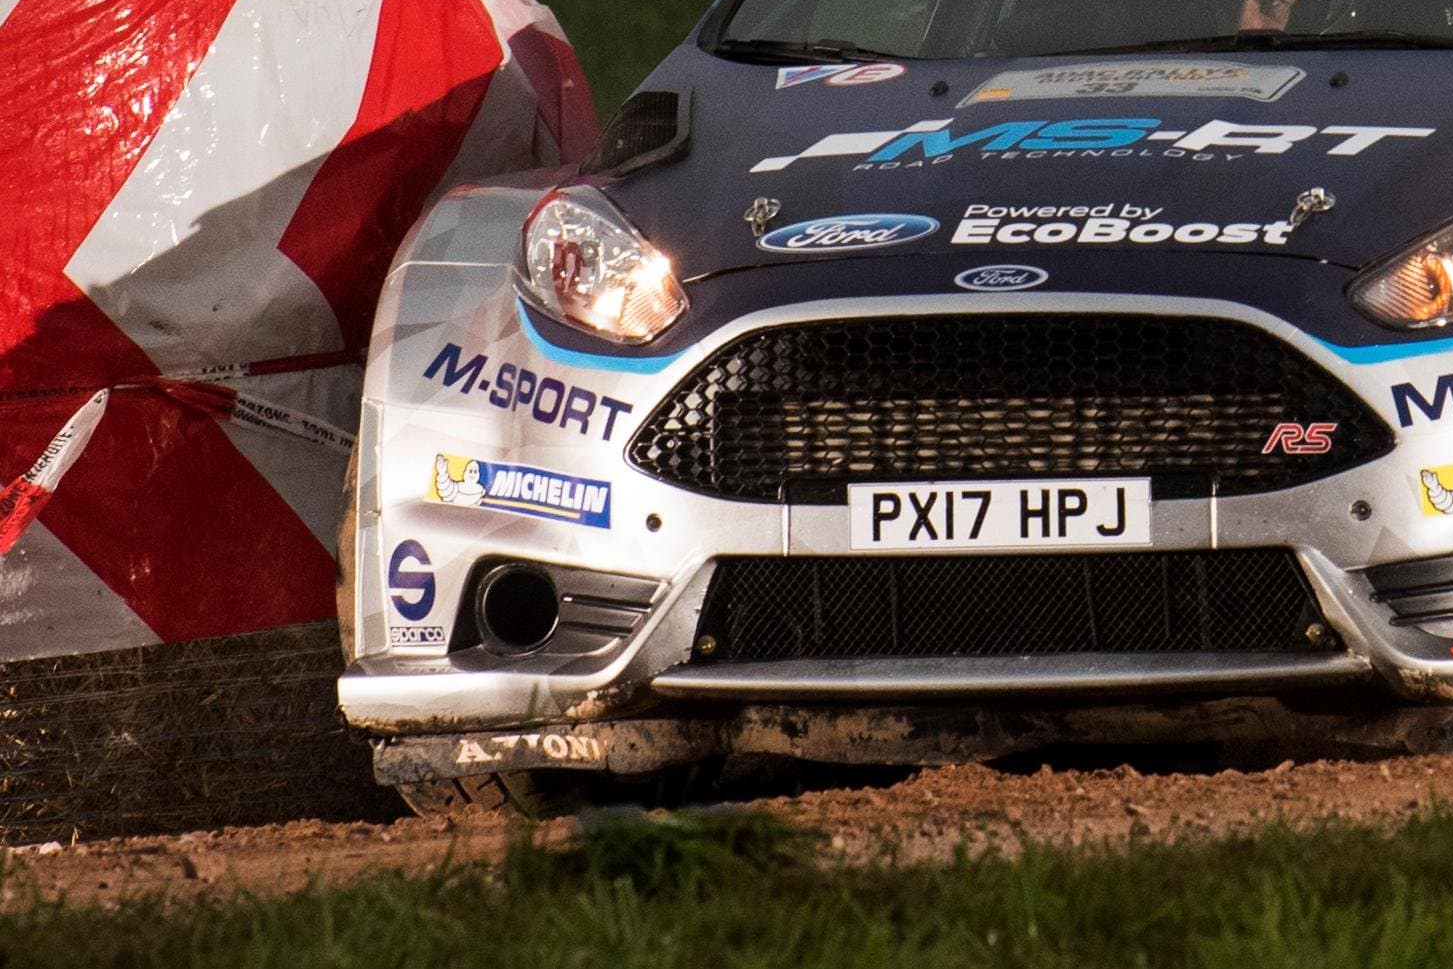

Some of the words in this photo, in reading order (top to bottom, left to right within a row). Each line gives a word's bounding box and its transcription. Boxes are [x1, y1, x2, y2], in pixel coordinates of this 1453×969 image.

[867, 118, 1436, 161] MS-RT
[852, 156, 953, 171] ROAD
[981, 148, 1246, 162] TECHNOLOGY
[963, 203, 1114, 220] Powered
[1119, 203, 1163, 223] by
[796, 218, 905, 248] Ford
[951, 218, 1298, 245] EcoBoost
[423, 342, 634, 442] M-SPORT
[1261, 423, 1338, 454] RS
[489, 470, 608, 515] MICHELIN
[872, 490, 991, 541] PX17
[1019, 487, 1126, 539] HPJ
[391, 626, 444, 645] sparco
